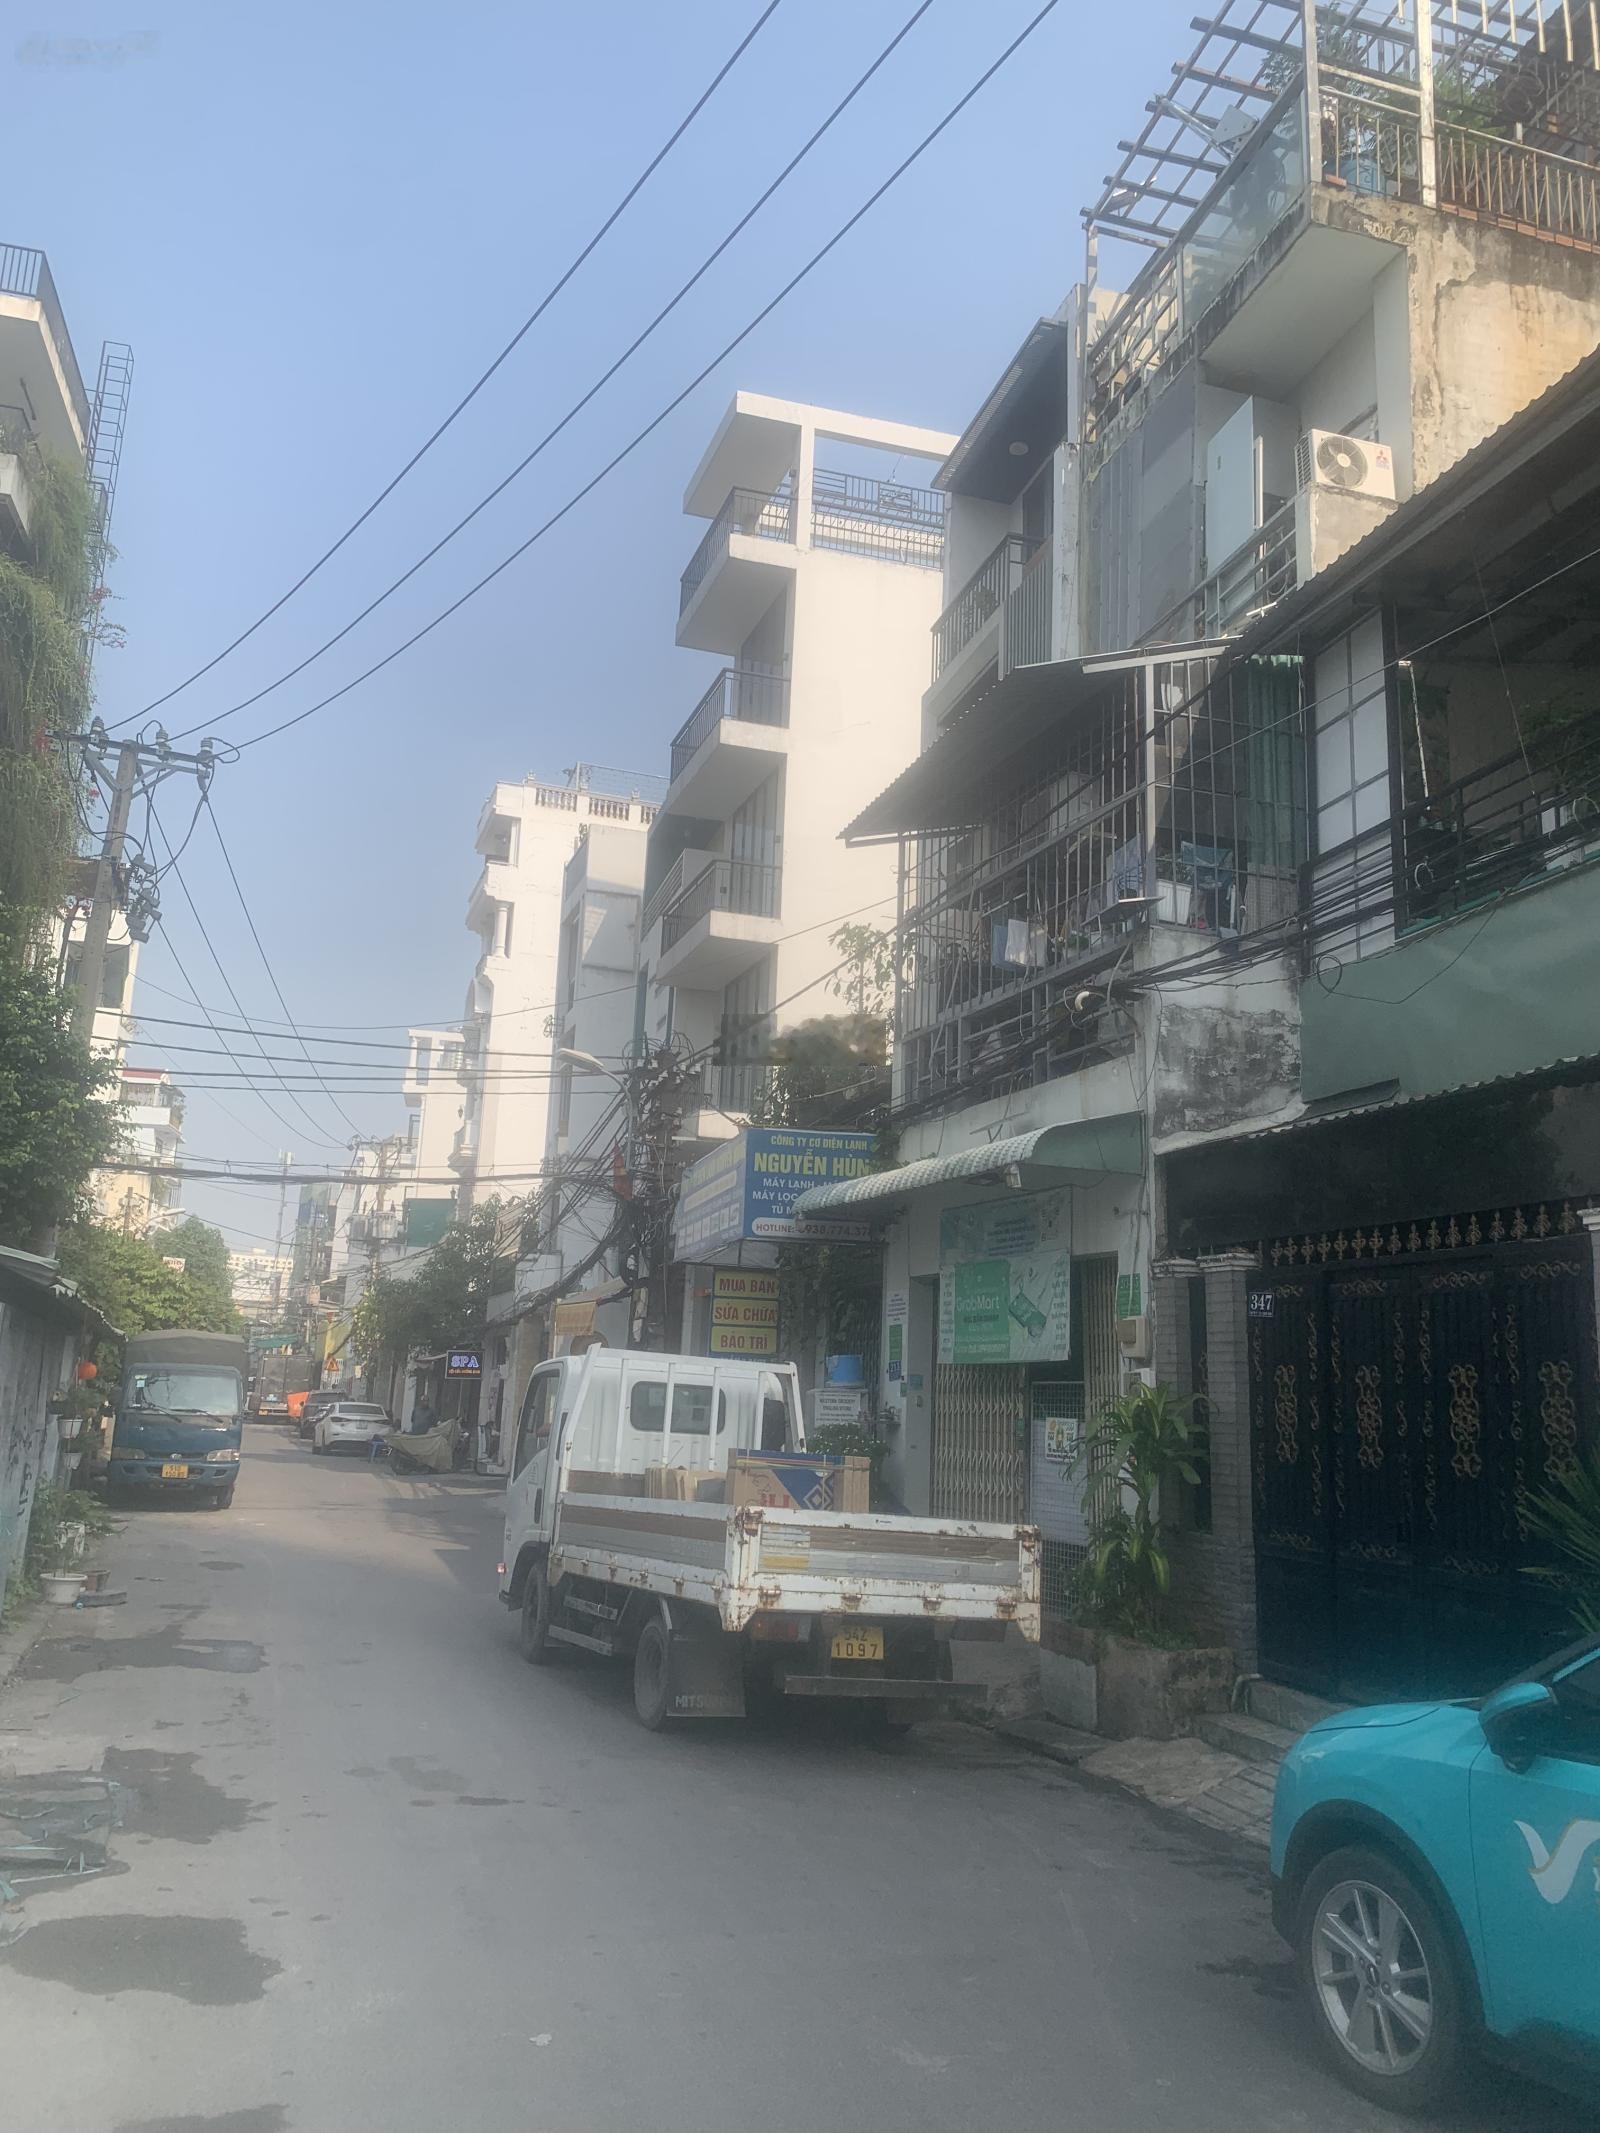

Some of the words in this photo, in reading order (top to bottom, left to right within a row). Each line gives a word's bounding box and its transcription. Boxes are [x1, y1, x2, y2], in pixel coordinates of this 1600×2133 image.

[771, 1135, 794, 1147] CÔNG
[797, 1138, 807, 1148] TY
[845, 1140, 868, 1153] LẠNH
[754, 1149, 827, 1176] NGUYỄN
[763, 1177, 785, 1188] MÁY
[788, 1180, 815, 1192] LẠNH
[752, 1188, 775, 1201] MÁY
[720, 1278, 746, 1292] MUA
[1251, 1294, 1273, 1311] 347
[715, 1303, 738, 1321] SỬA
[451, 1355, 480, 1368] SPA
[836, 1643, 878, 1658] 1097
